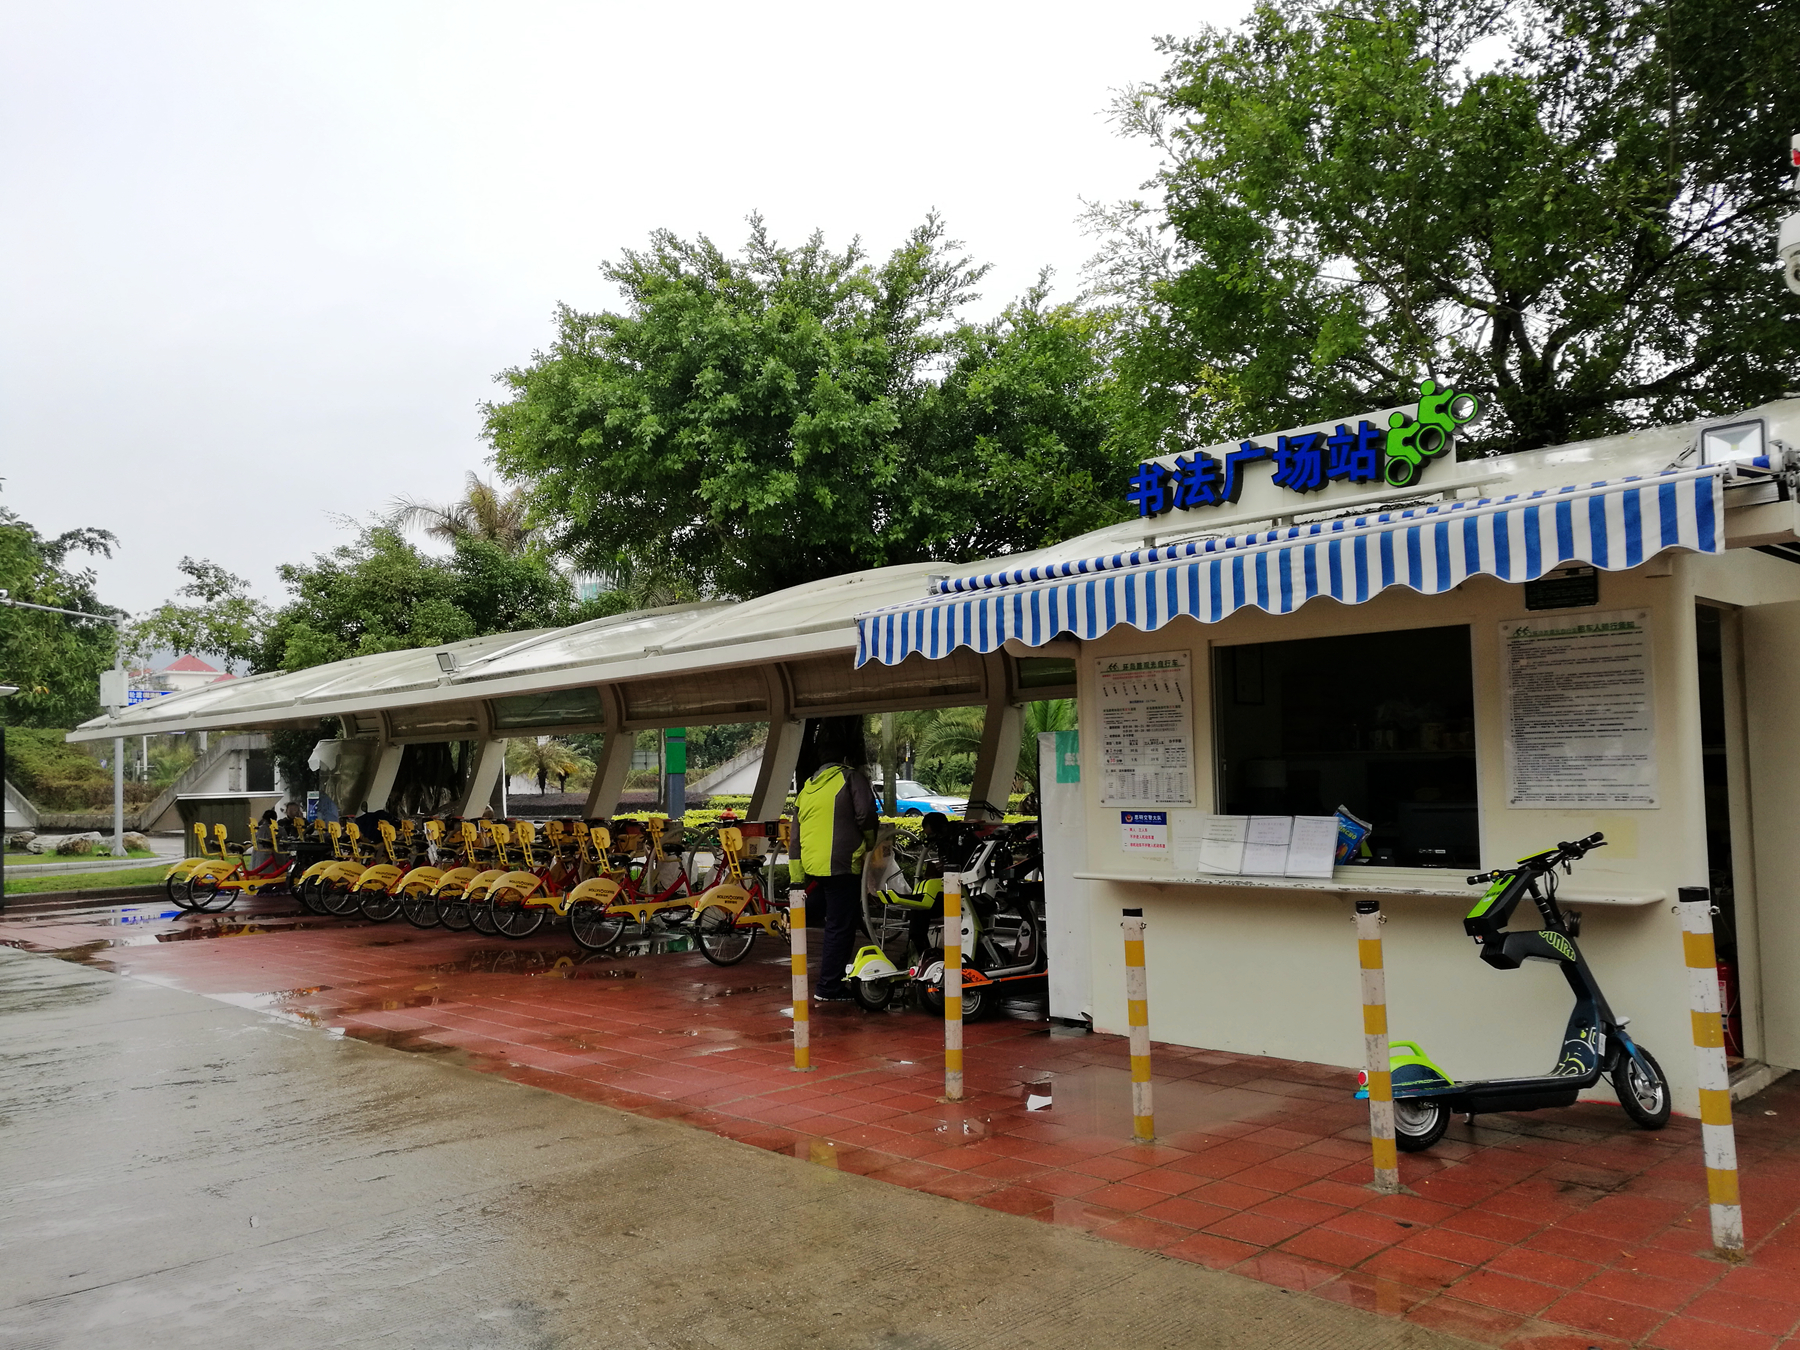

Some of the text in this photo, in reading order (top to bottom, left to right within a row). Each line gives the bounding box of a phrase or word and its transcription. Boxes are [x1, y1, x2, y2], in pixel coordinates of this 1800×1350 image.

[1126, 419, 1385, 518] 书法广场站
